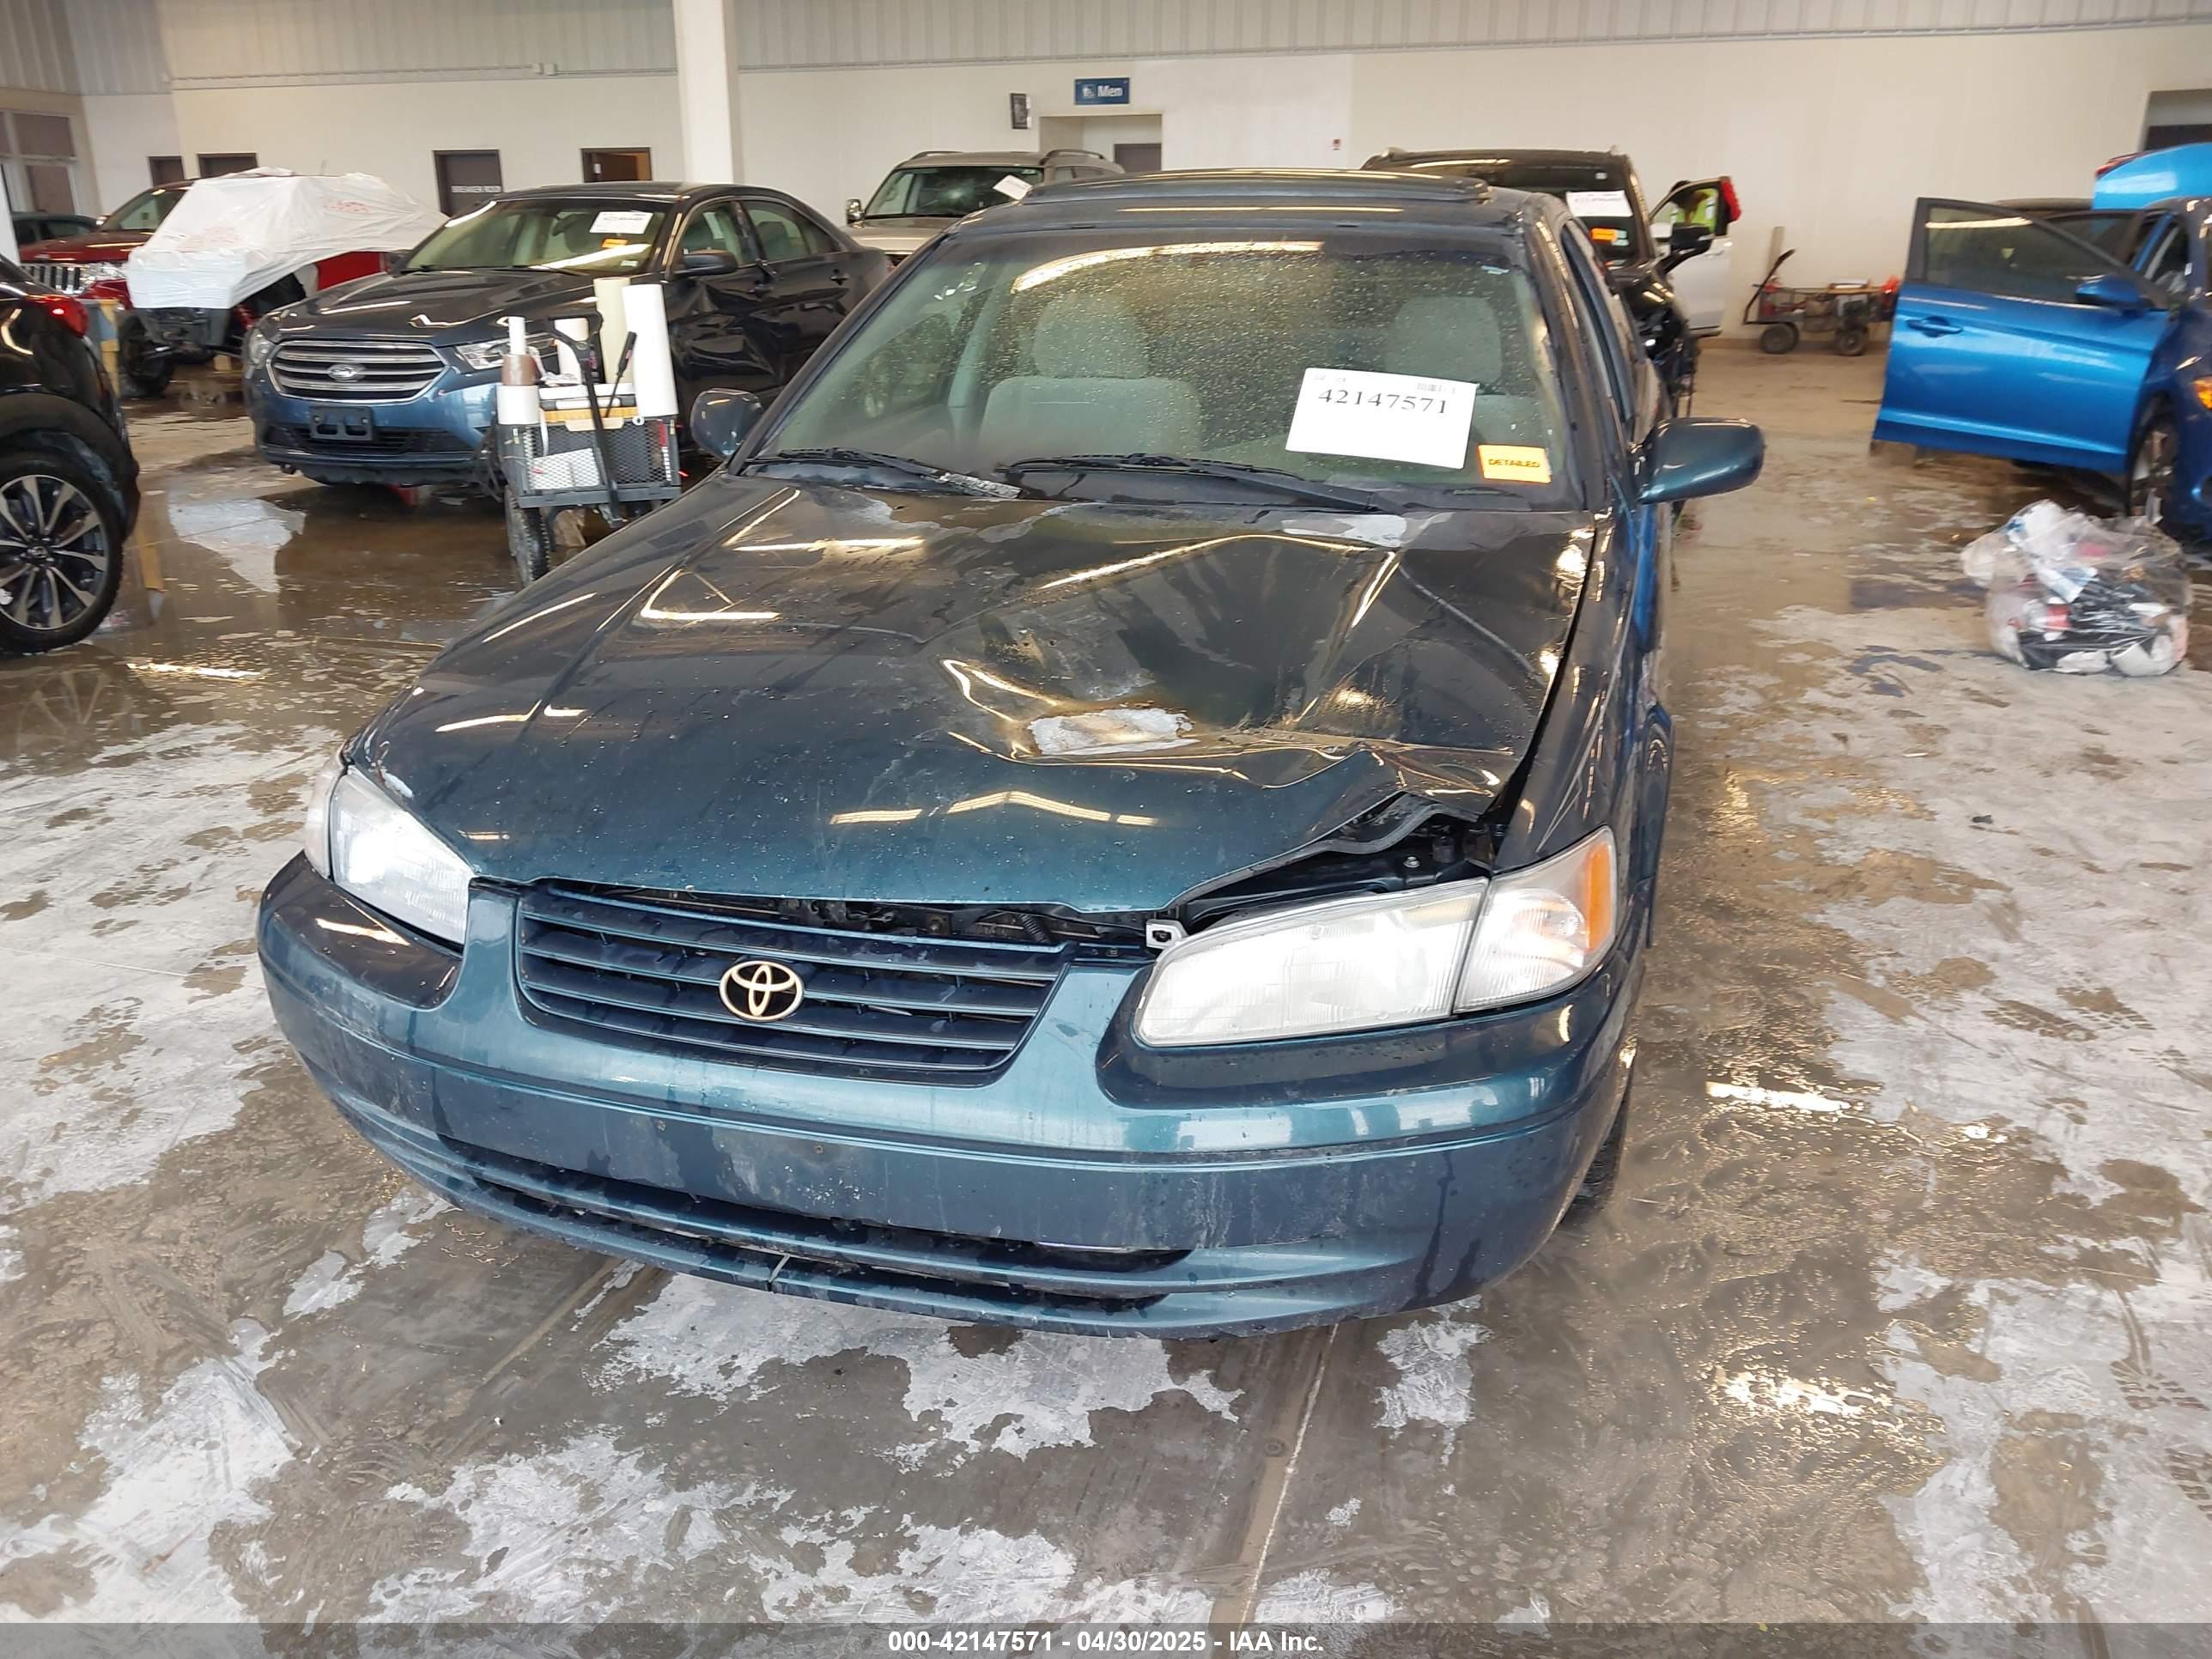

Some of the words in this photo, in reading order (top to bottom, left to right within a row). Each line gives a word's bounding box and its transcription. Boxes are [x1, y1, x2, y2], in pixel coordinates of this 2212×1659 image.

[1097, 85, 1123, 97] Men
[1318, 388, 1447, 414] 42147571
[1488, 459, 1540, 468] DETAILED
